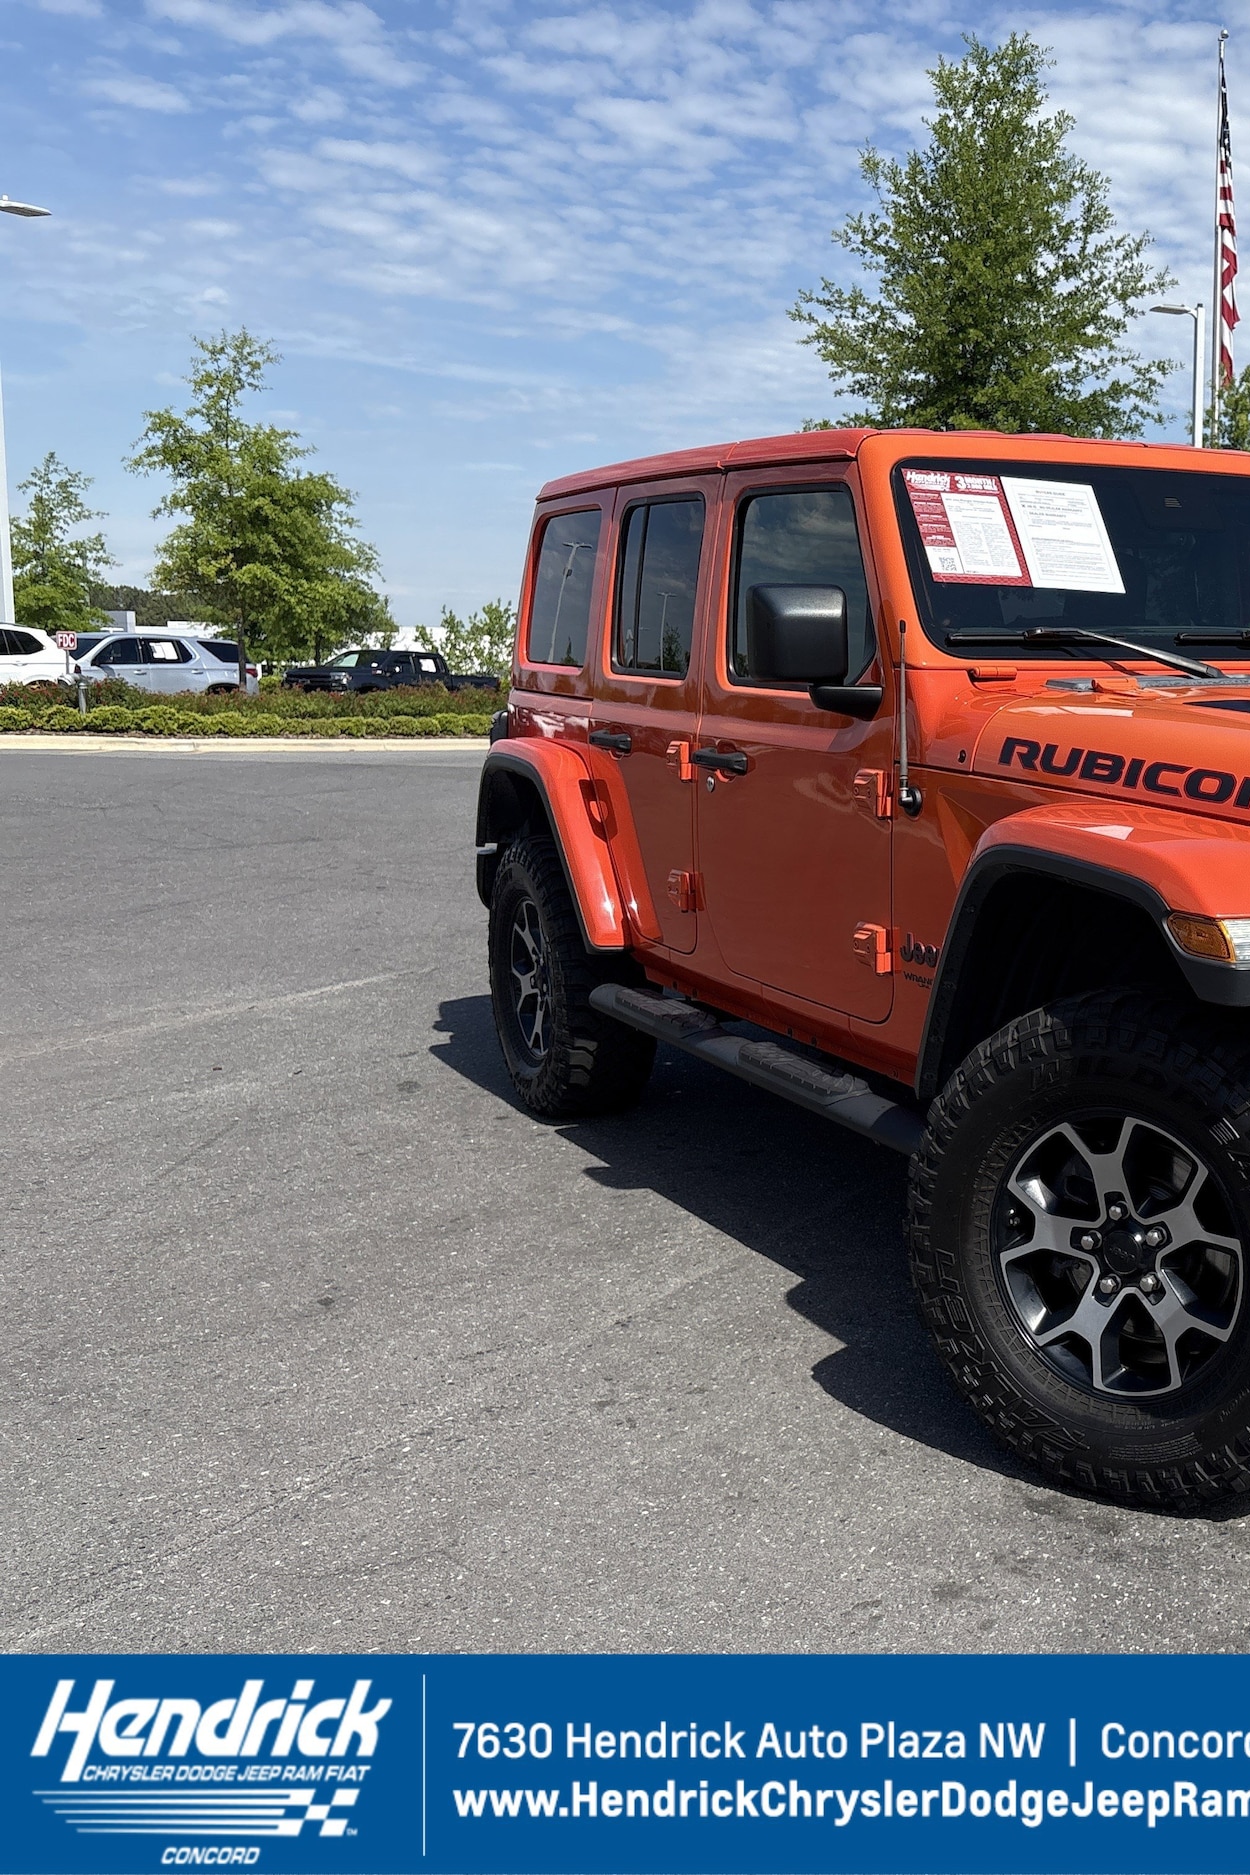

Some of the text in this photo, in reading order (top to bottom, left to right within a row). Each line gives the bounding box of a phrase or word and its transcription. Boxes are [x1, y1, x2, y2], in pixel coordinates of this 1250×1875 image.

[955, 475, 966, 490] 3
[57, 633, 75, 647] FDC
[900, 931, 941, 968] Jee
